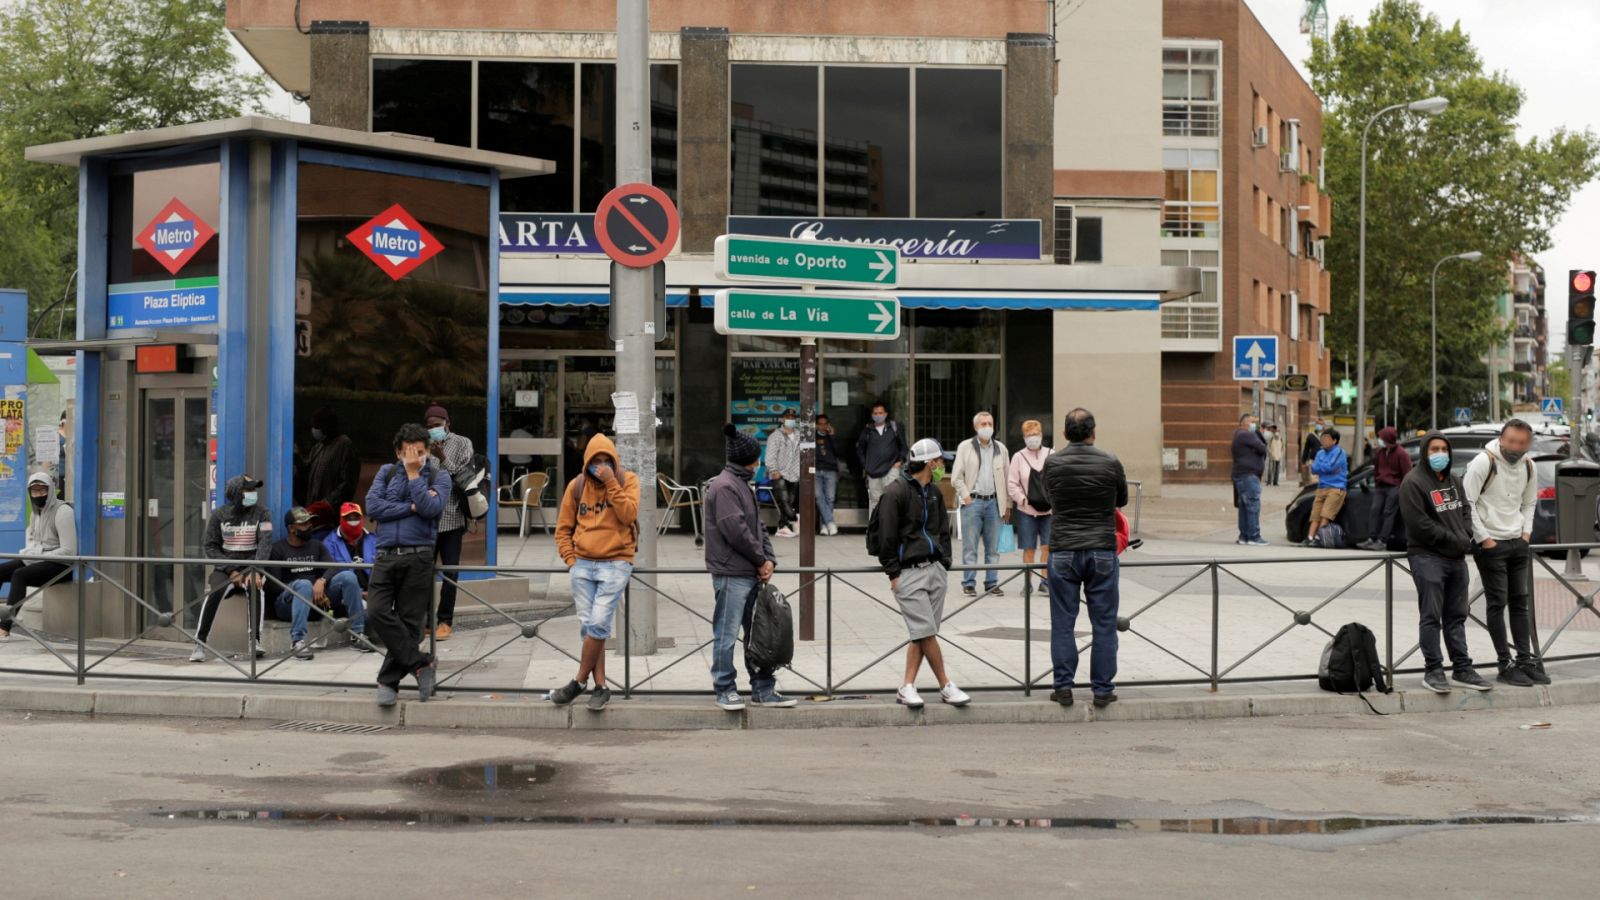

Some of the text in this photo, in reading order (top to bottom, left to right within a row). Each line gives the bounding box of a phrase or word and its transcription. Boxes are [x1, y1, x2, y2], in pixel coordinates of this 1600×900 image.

[157, 228, 192, 245] Metro
[375, 231, 417, 252] Metro
[730, 252, 847, 270] avenida de Oporto
[144, 293, 206, 310] Plaza Elíptica
[730, 309, 756, 319] calle
[762, 310, 775, 320] de
[780, 306, 797, 321] La
[761, 361, 800, 369] YAKART
[0, 401, 23, 410] PRO
